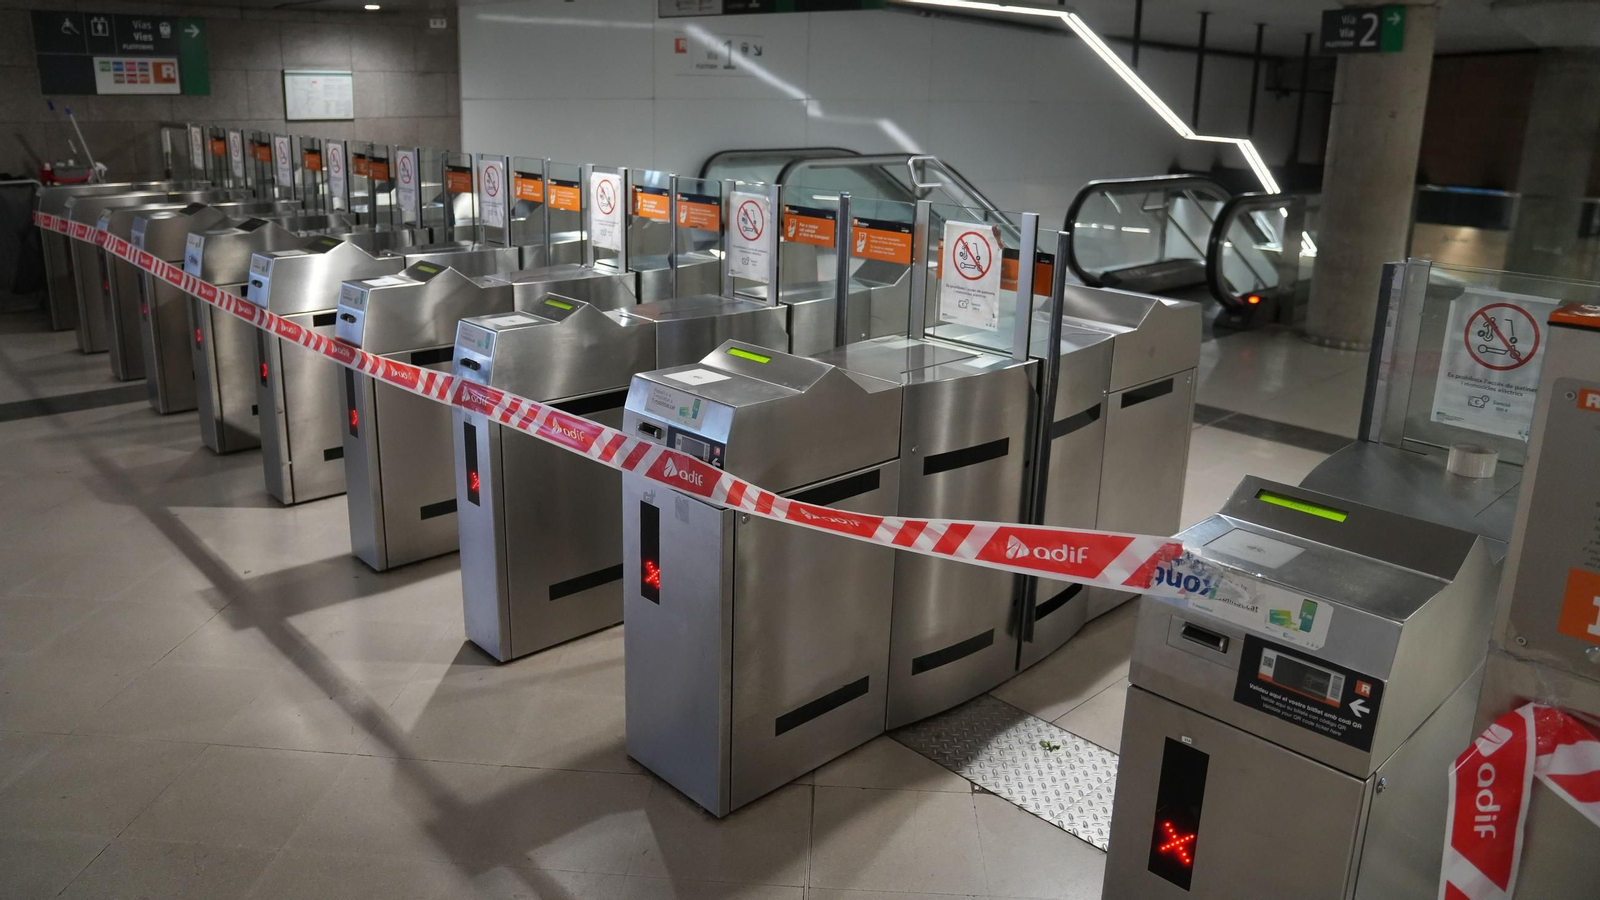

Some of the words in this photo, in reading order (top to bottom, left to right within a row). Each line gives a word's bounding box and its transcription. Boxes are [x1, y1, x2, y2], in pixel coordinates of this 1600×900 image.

[1360, 13, 1378, 47] 2
[722, 40, 737, 70] 1
[161, 65, 175, 80] R
[470, 394, 490, 407] adif
[561, 427, 586, 442] adif
[679, 470, 704, 486] adif
[1033, 544, 1089, 564] adif
[1361, 684, 1370, 695] R
[1249, 683, 1269, 695] Valideu
[1288, 697, 1306, 708] vostre
[1307, 703, 1324, 715] bitllet
[1324, 711, 1337, 721] amb
[1338, 716, 1351, 726] codi
[1352, 721, 1362, 729] QR
[1337, 723, 1347, 731] QR
[1474, 762, 1500, 839] adif
